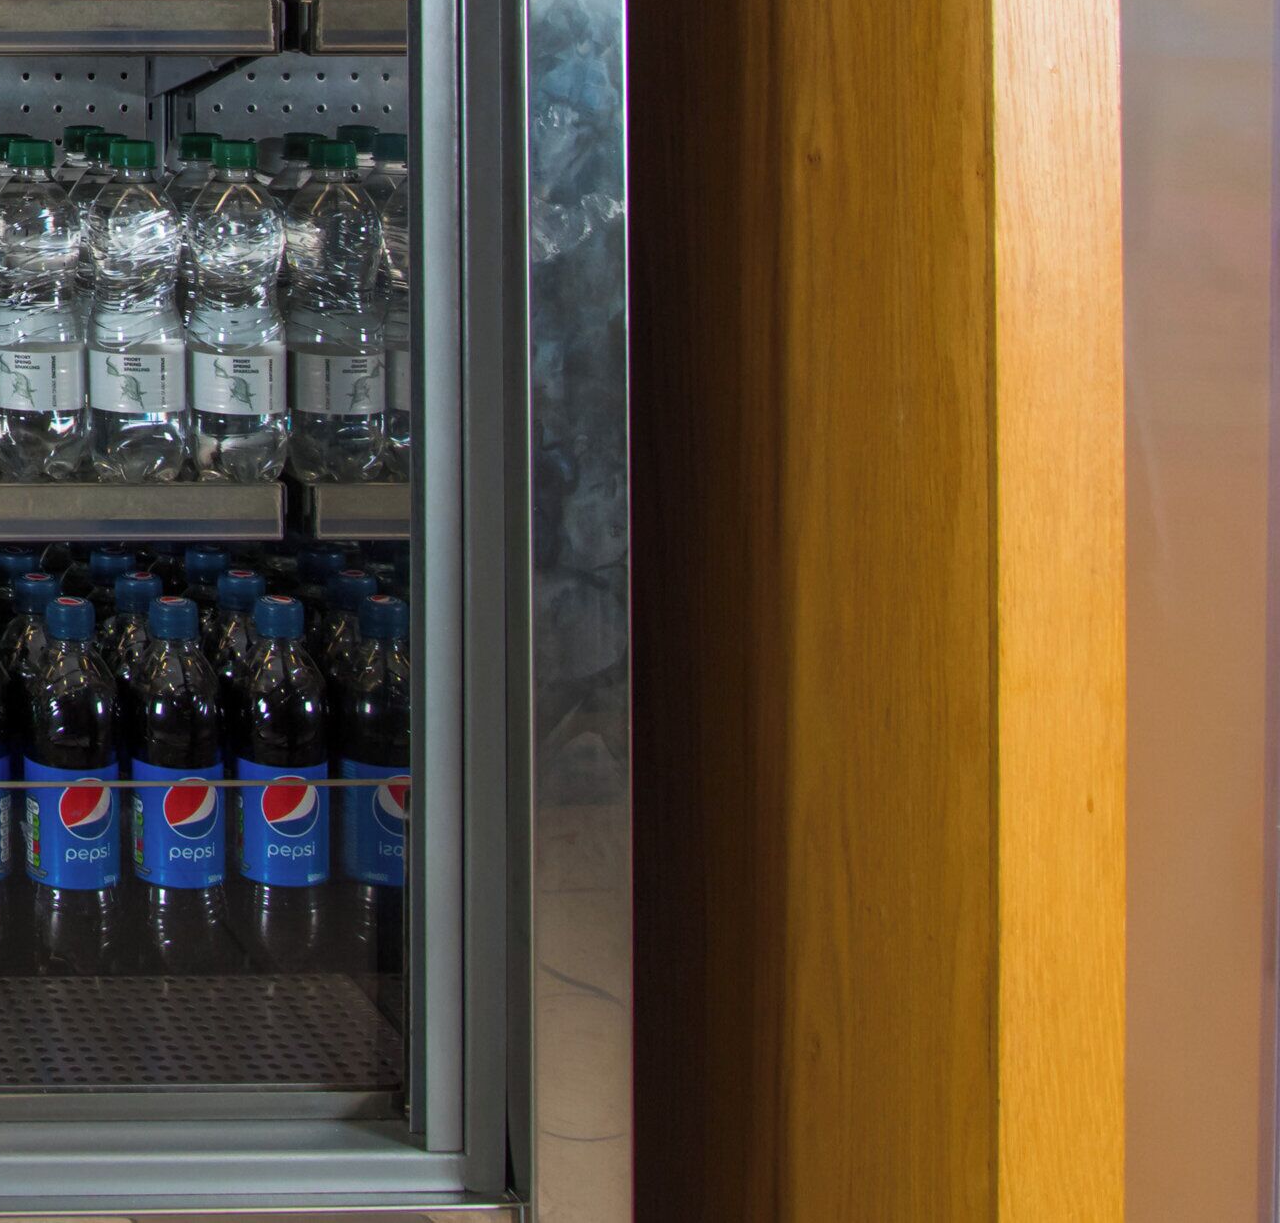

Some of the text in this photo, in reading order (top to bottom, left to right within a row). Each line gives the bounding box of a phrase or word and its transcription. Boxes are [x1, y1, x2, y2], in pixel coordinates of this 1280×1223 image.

[65, 842, 111, 864] pepsi
[169, 842, 215, 863] pepsi
[268, 841, 316, 863] pepsi
